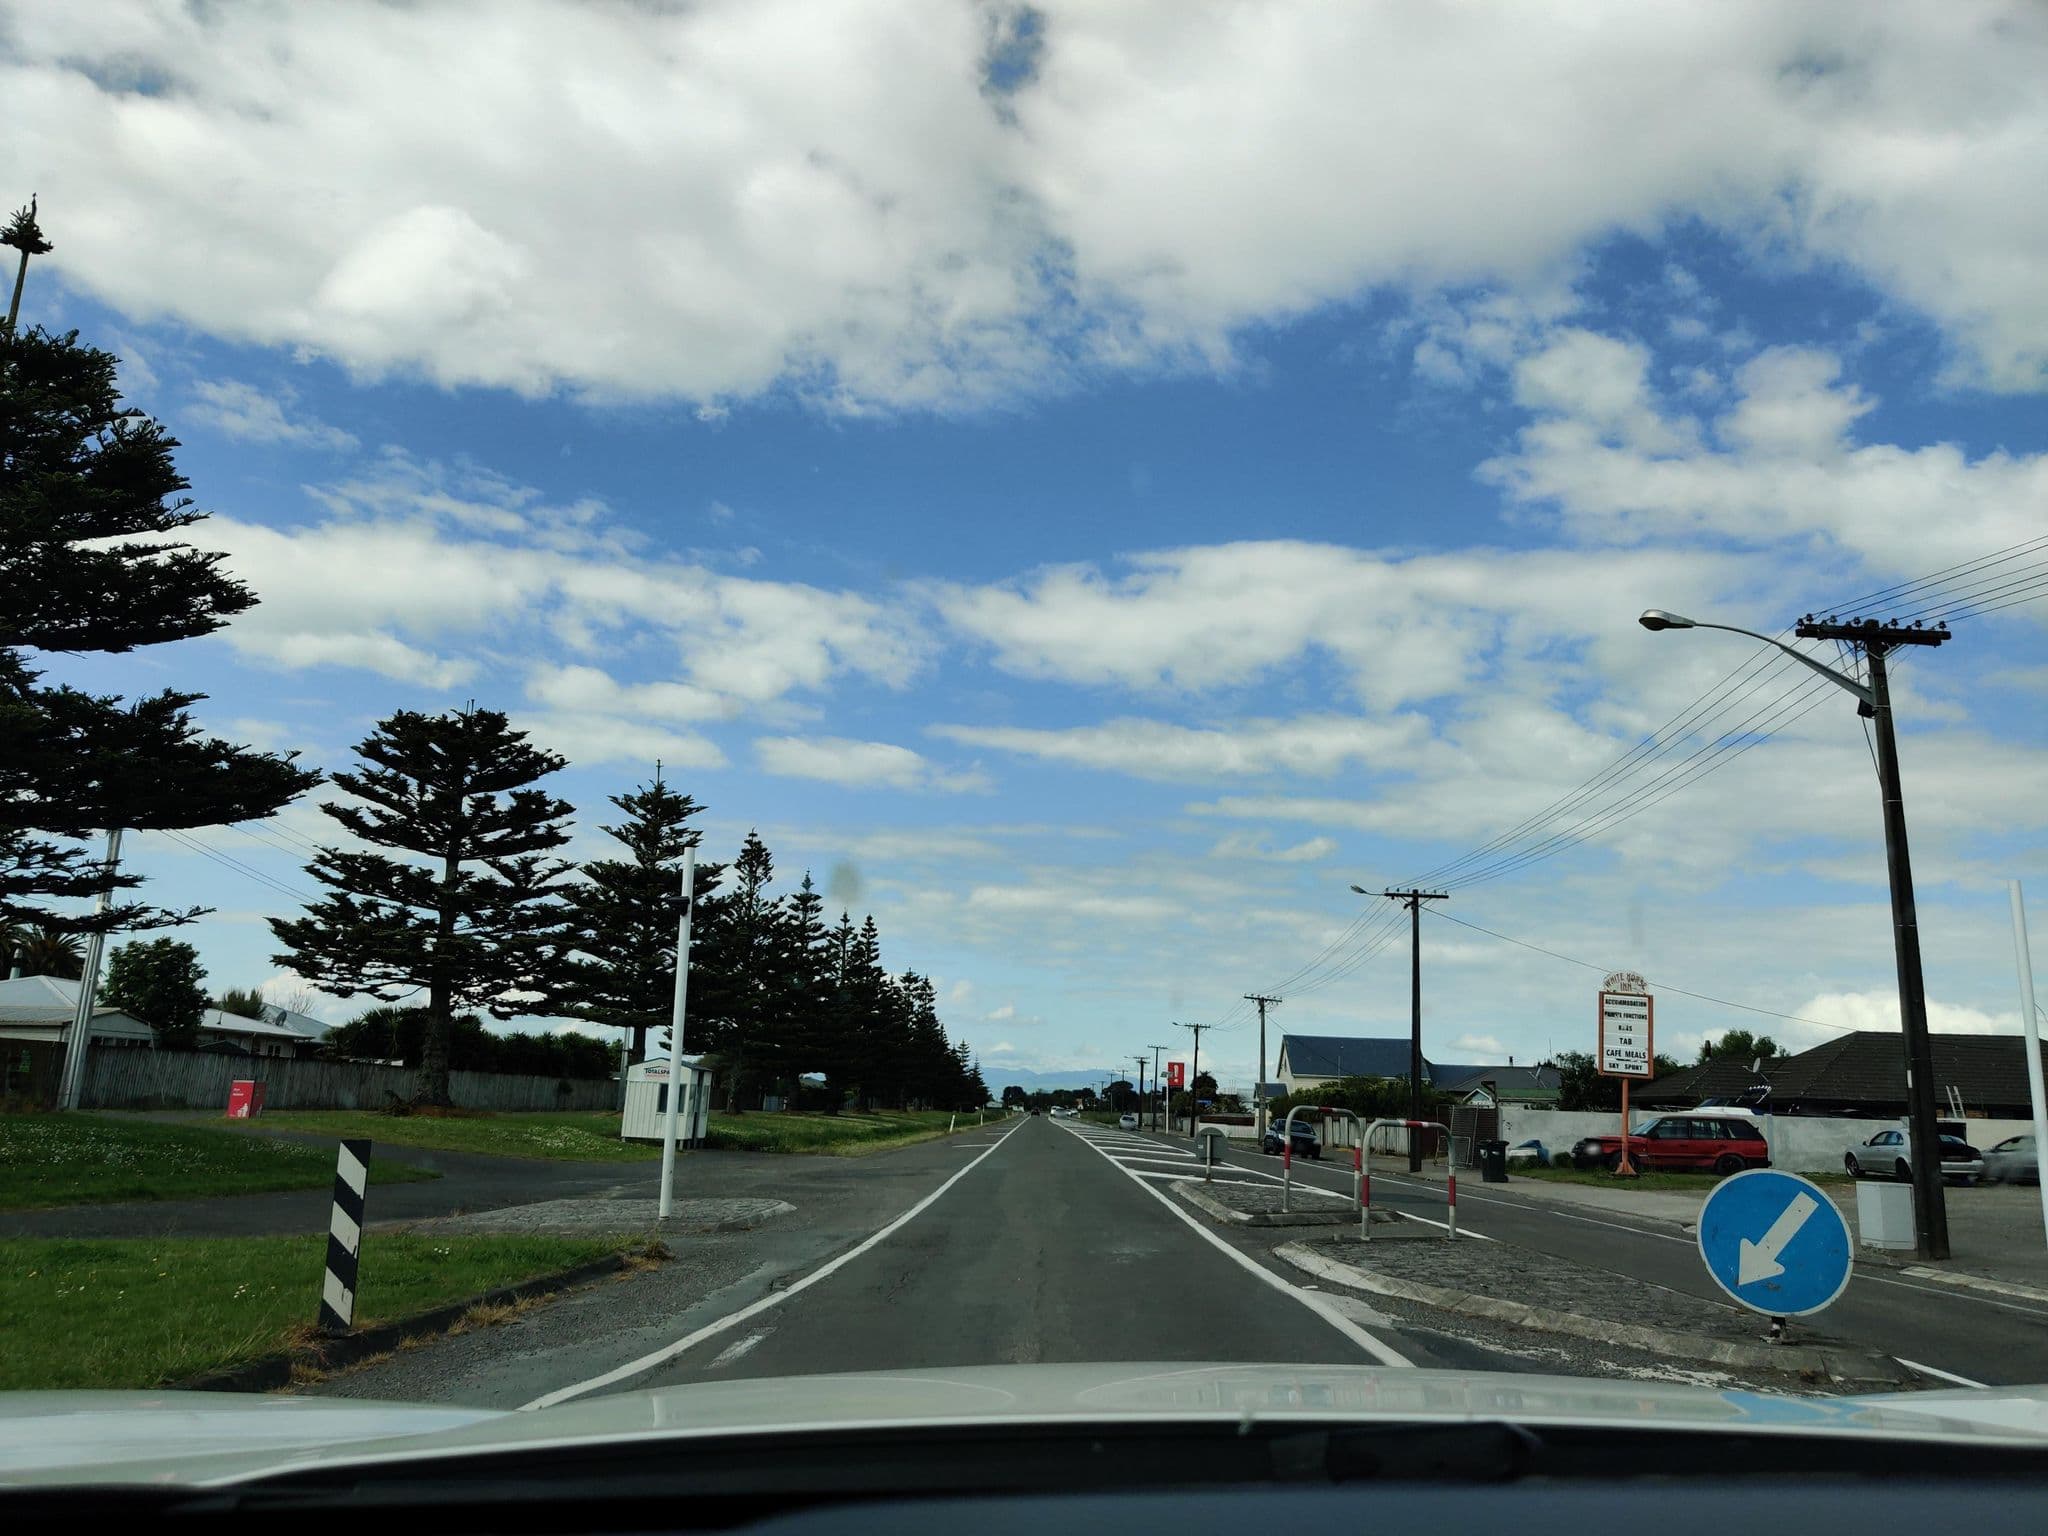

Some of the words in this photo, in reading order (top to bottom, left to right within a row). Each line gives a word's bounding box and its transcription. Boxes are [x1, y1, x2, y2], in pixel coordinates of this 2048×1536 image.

[1604, 973, 1624, 989] WHITE
[1620, 982, 1632, 992] INN
[1619, 1037, 1632, 1045] TAB
[1624, 1050, 1646, 1059] MEALS
